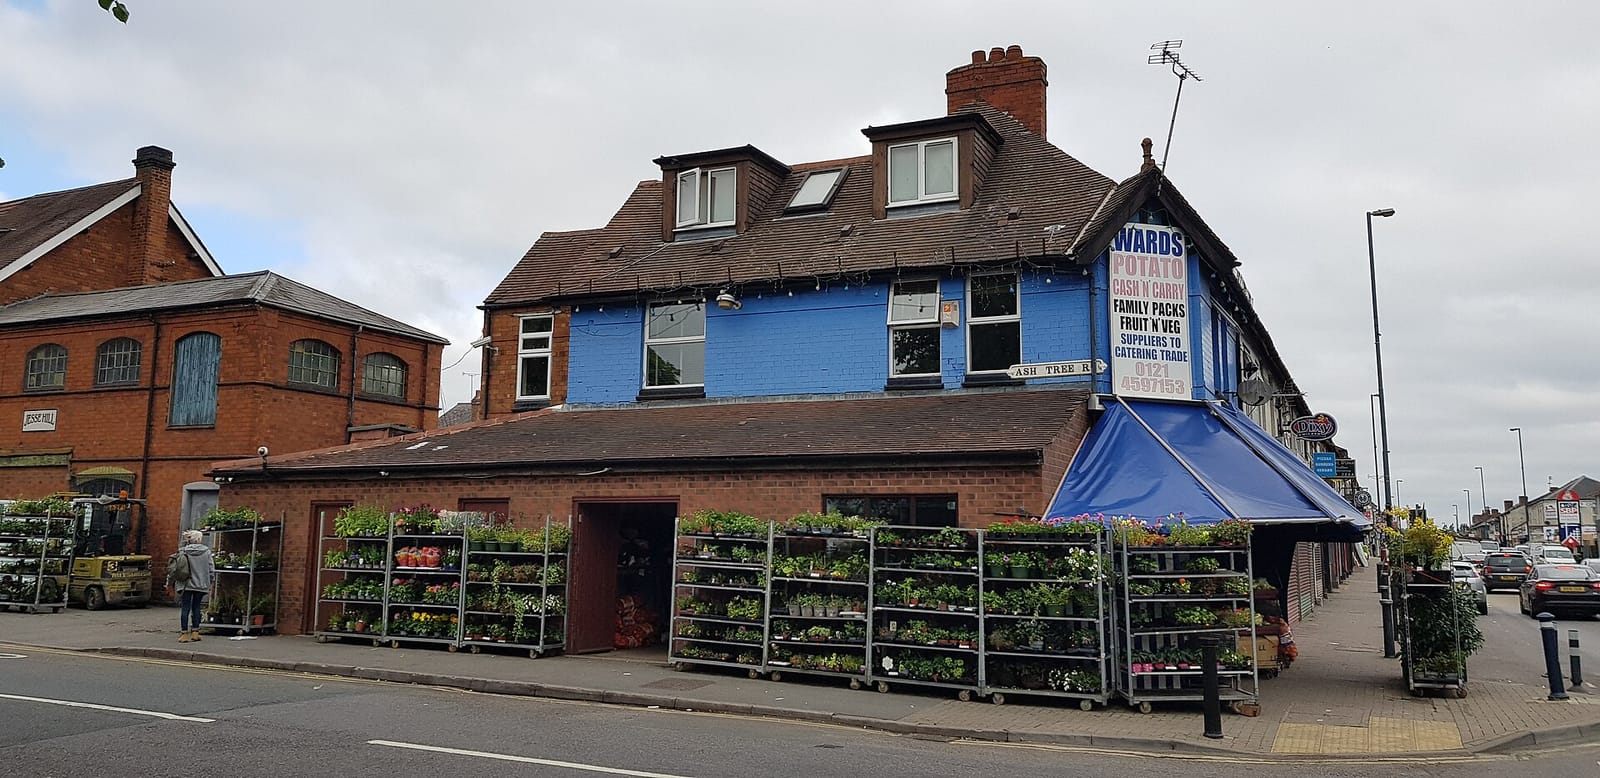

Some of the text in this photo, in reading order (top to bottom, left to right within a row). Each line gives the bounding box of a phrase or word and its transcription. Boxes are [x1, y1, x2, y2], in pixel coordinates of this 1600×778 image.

[1114, 228, 1184, 258] WARDS
[1113, 253, 1184, 280] POTATO
[1113, 278, 1139, 297] CASH
[1152, 283, 1185, 300] CARRY
[1113, 299, 1186, 318] FAMILY PACKS
[1120, 316, 1148, 332] FRUIT
[1161, 319, 1181, 334] VEG
[1120, 333, 1181, 349] SUPPLIERS TO
[1115, 347, 1188, 362] CATERING TRADE
[1015, 367, 1037, 376] ASH
[1045, 364, 1075, 374] TREE
[1135, 361, 1169, 378] 0121
[1121, 377, 1185, 394] 4597153
[24, 412, 54, 427] JESSE HILL
[1298, 420, 1331, 435] Dixy
